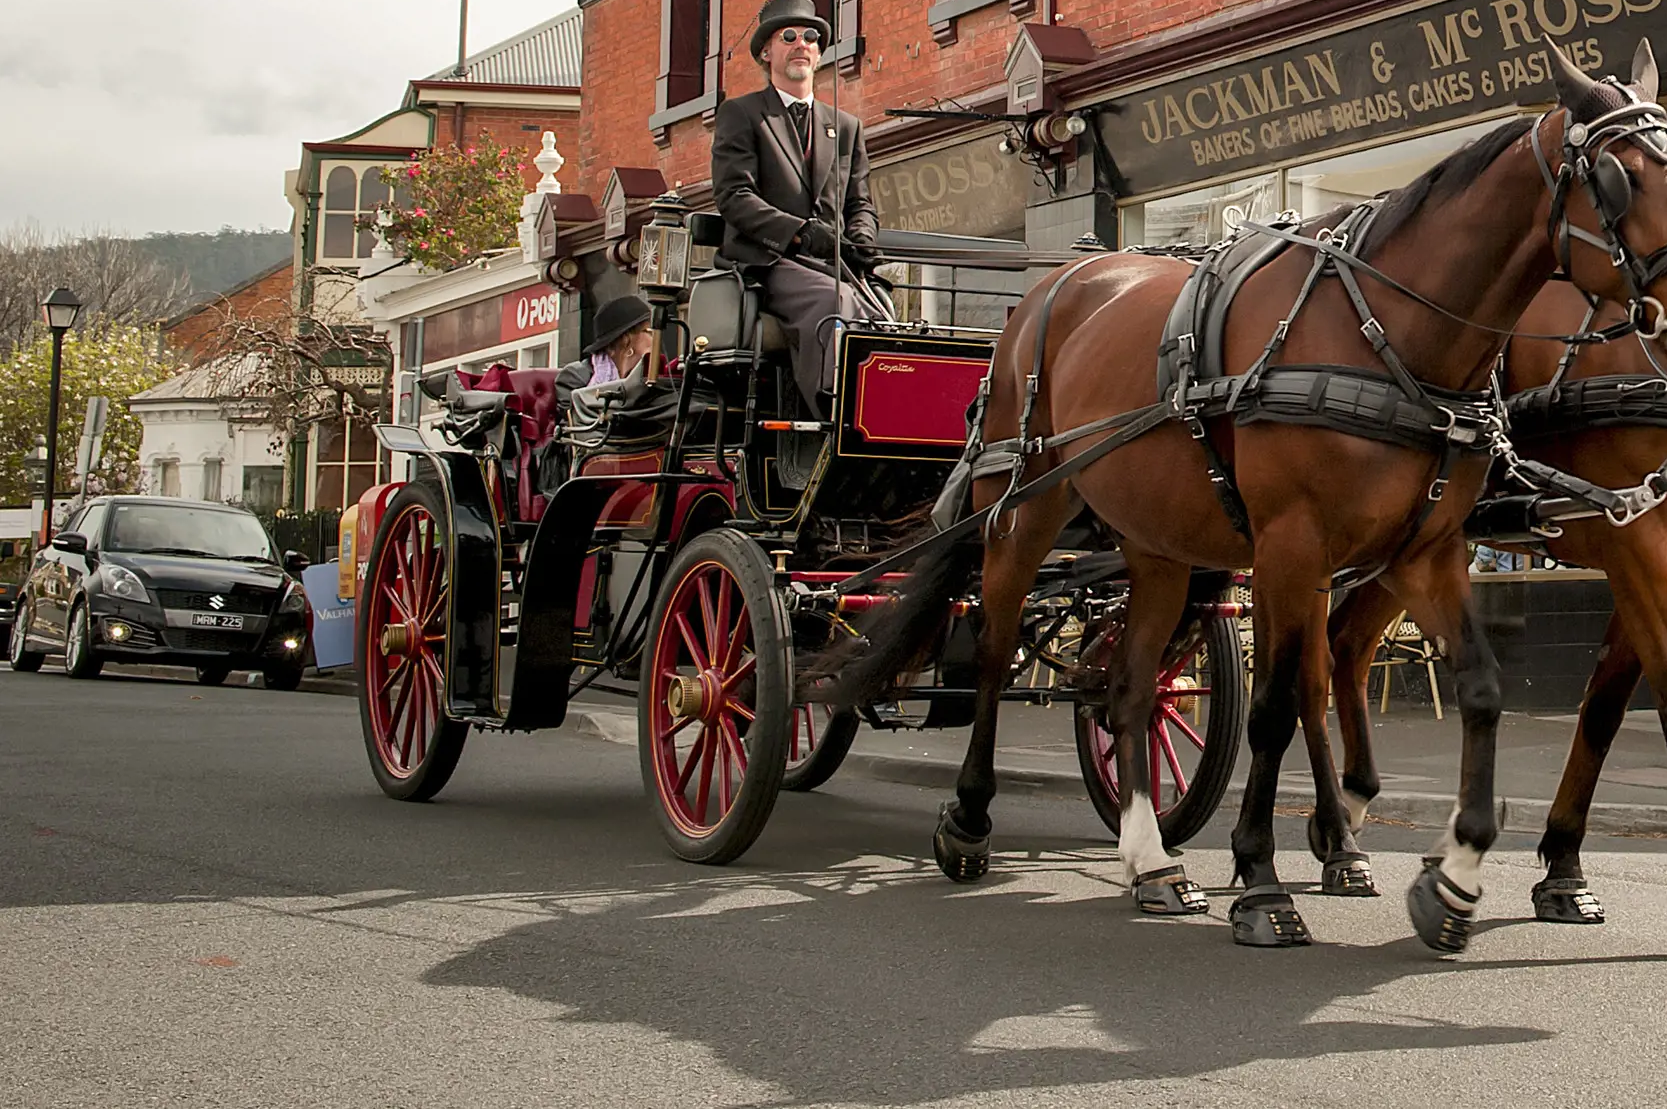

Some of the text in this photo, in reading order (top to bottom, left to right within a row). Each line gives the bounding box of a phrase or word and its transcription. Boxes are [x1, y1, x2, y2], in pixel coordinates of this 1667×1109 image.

[1141, 50, 1342, 144] JACKMAN
[1370, 40, 1396, 84] &
[1190, 37, 1604, 167] BAKERS OF FINE BREADS, CAKES & PASTIES
[900, 202, 956, 232] PASTRIES
[316, 607, 356, 621] VALHA
